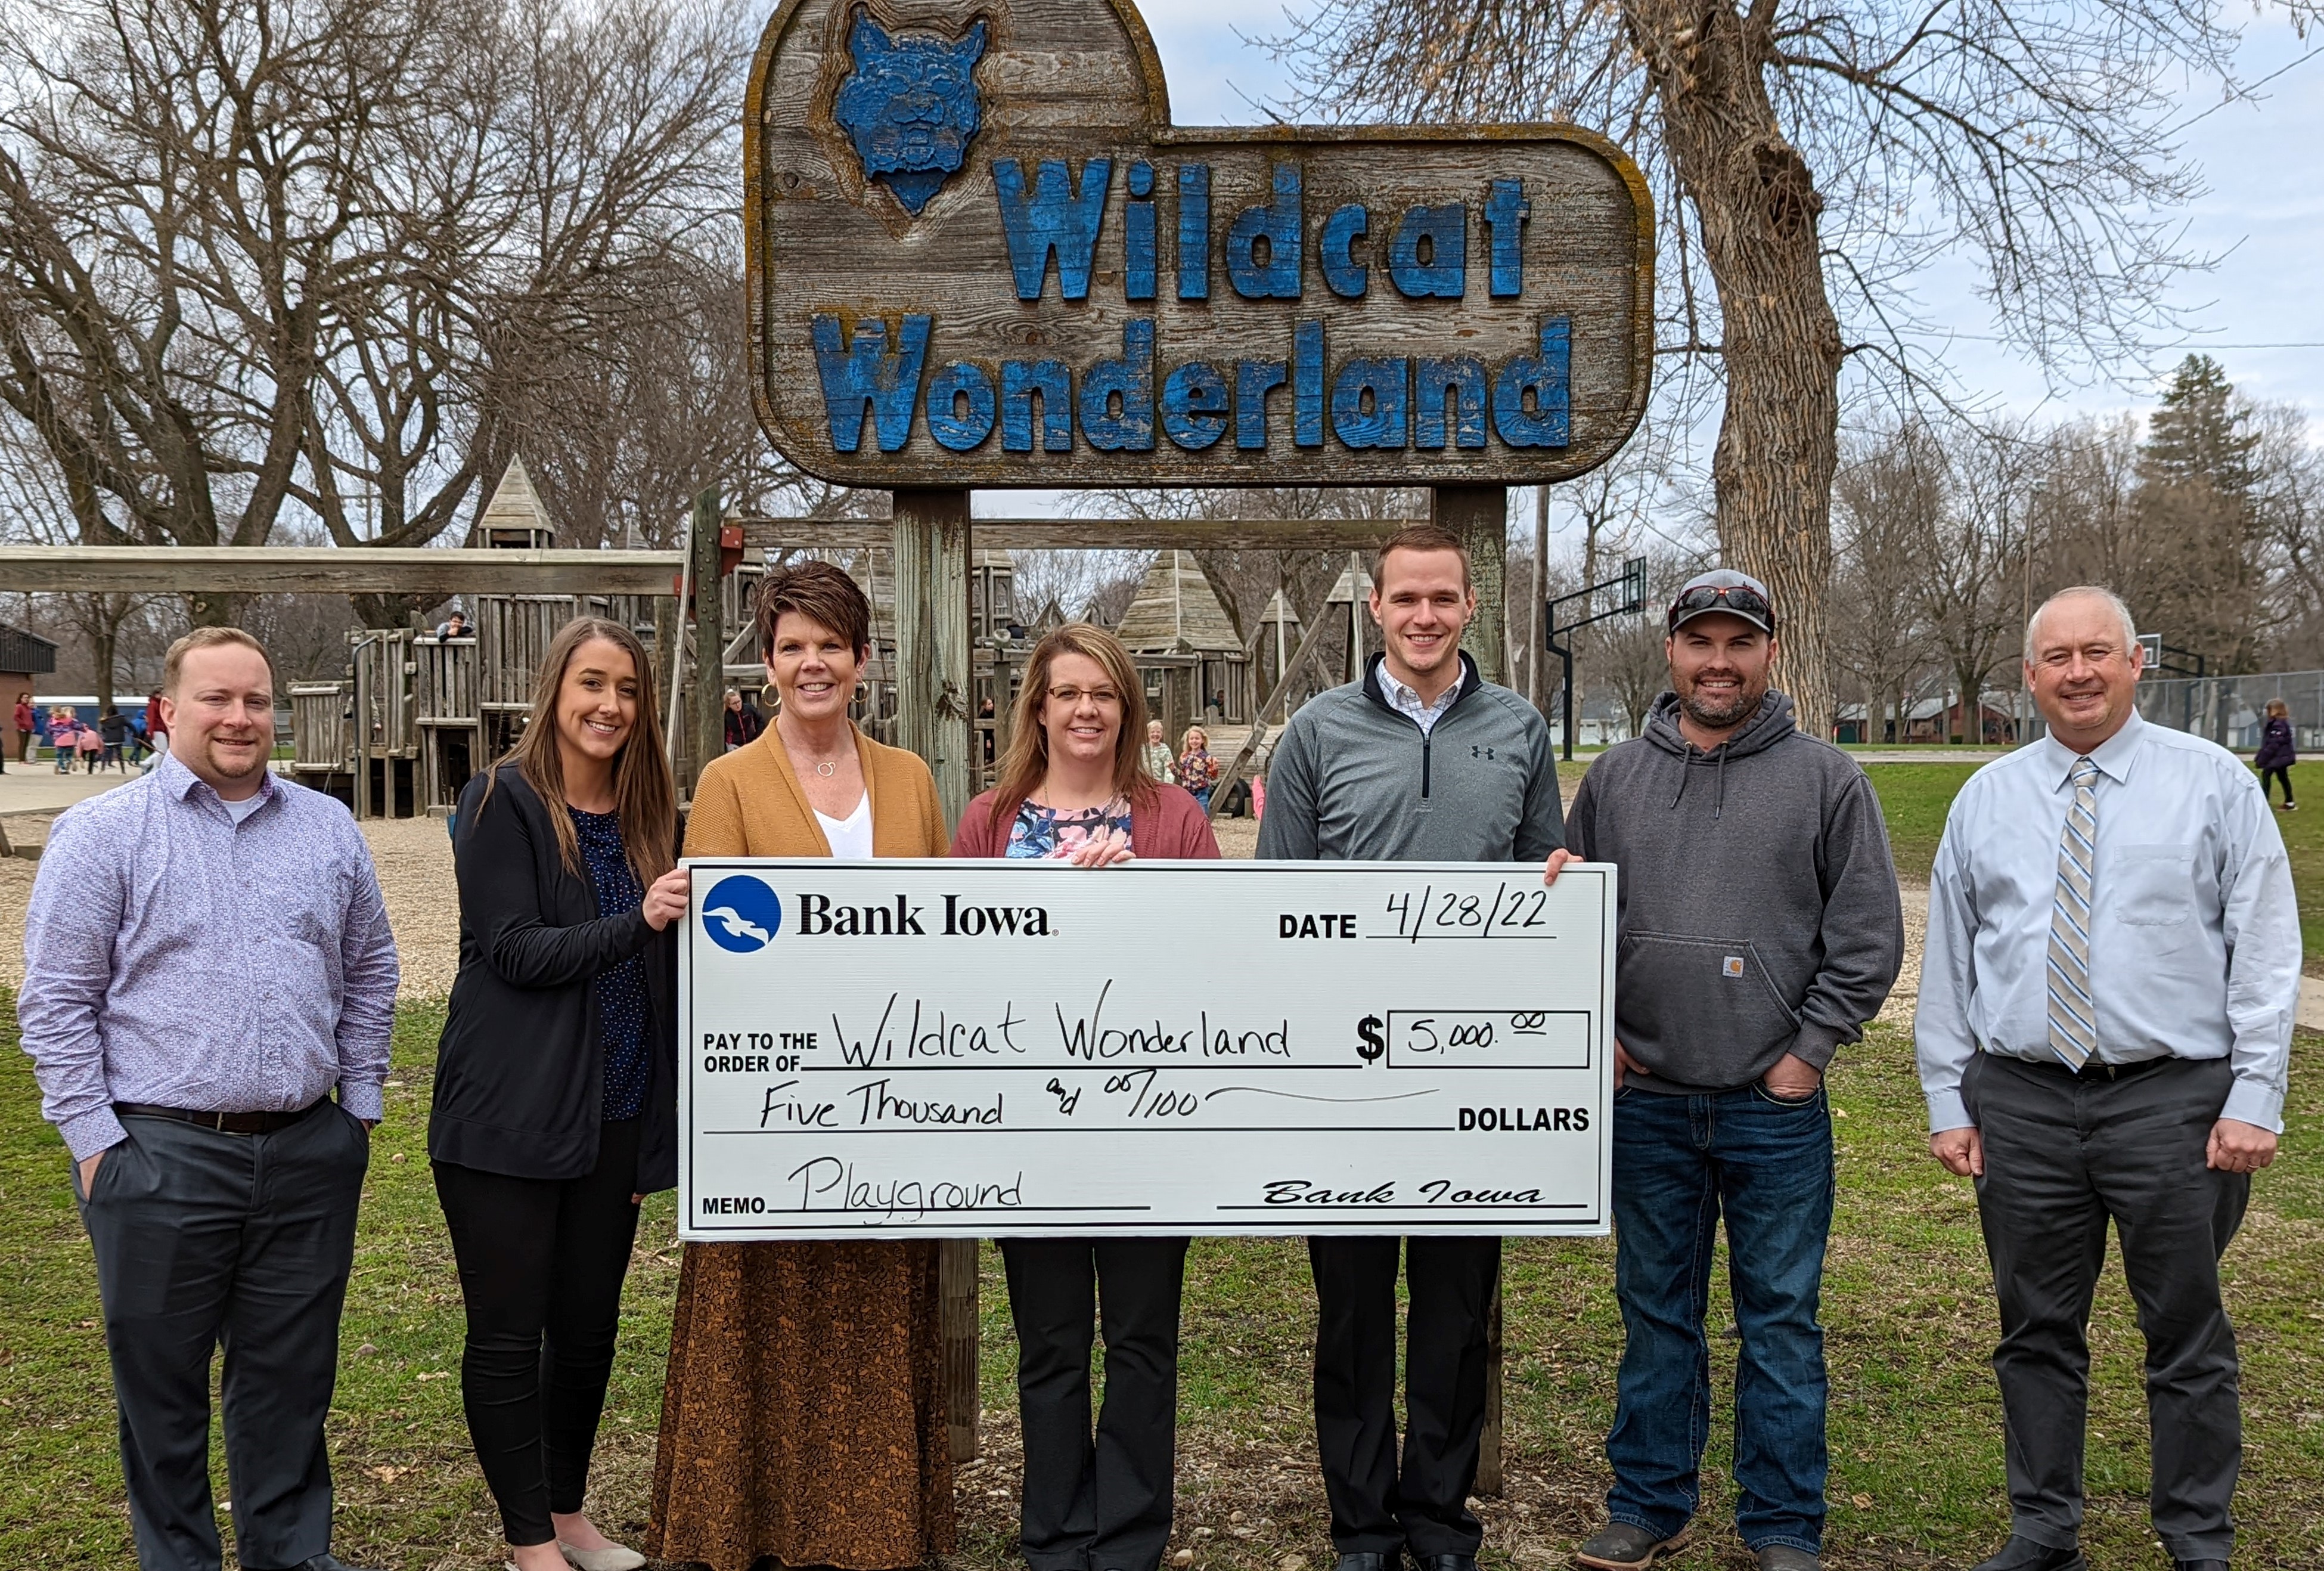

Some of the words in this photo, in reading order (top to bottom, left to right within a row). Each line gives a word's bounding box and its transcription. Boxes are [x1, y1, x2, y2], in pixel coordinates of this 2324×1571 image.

[992, 157, 1531, 302] Wildcat
[811, 314, 1572, 453] Wonderland
[796, 894, 926, 936] Bank
[1279, 914, 1357, 940] DATE
[1386, 882, 1548, 944] 4/28/22
[703, 1033, 740, 1050] PAY
[747, 1033, 774, 1050] TO
[780, 1033, 817, 1050] THE
[832, 992, 1026, 1067] Wildcat
[1056, 978, 1290, 1061] Wonderland
[1356, 1014, 1385, 1065] $
[704, 1056, 771, 1073] ORDER
[776, 1056, 800, 1072] OF
[760, 1080, 839, 1128] Five
[847, 1079, 1003, 1125] Thousand
[1458, 1108, 1590, 1132] DOLLARS
[703, 1198, 765, 1214] MEMO
[788, 1157, 1023, 1225] Playground
[1262, 1181, 1396, 1204] Bank
[1419, 1180, 1545, 1204] Iowa
